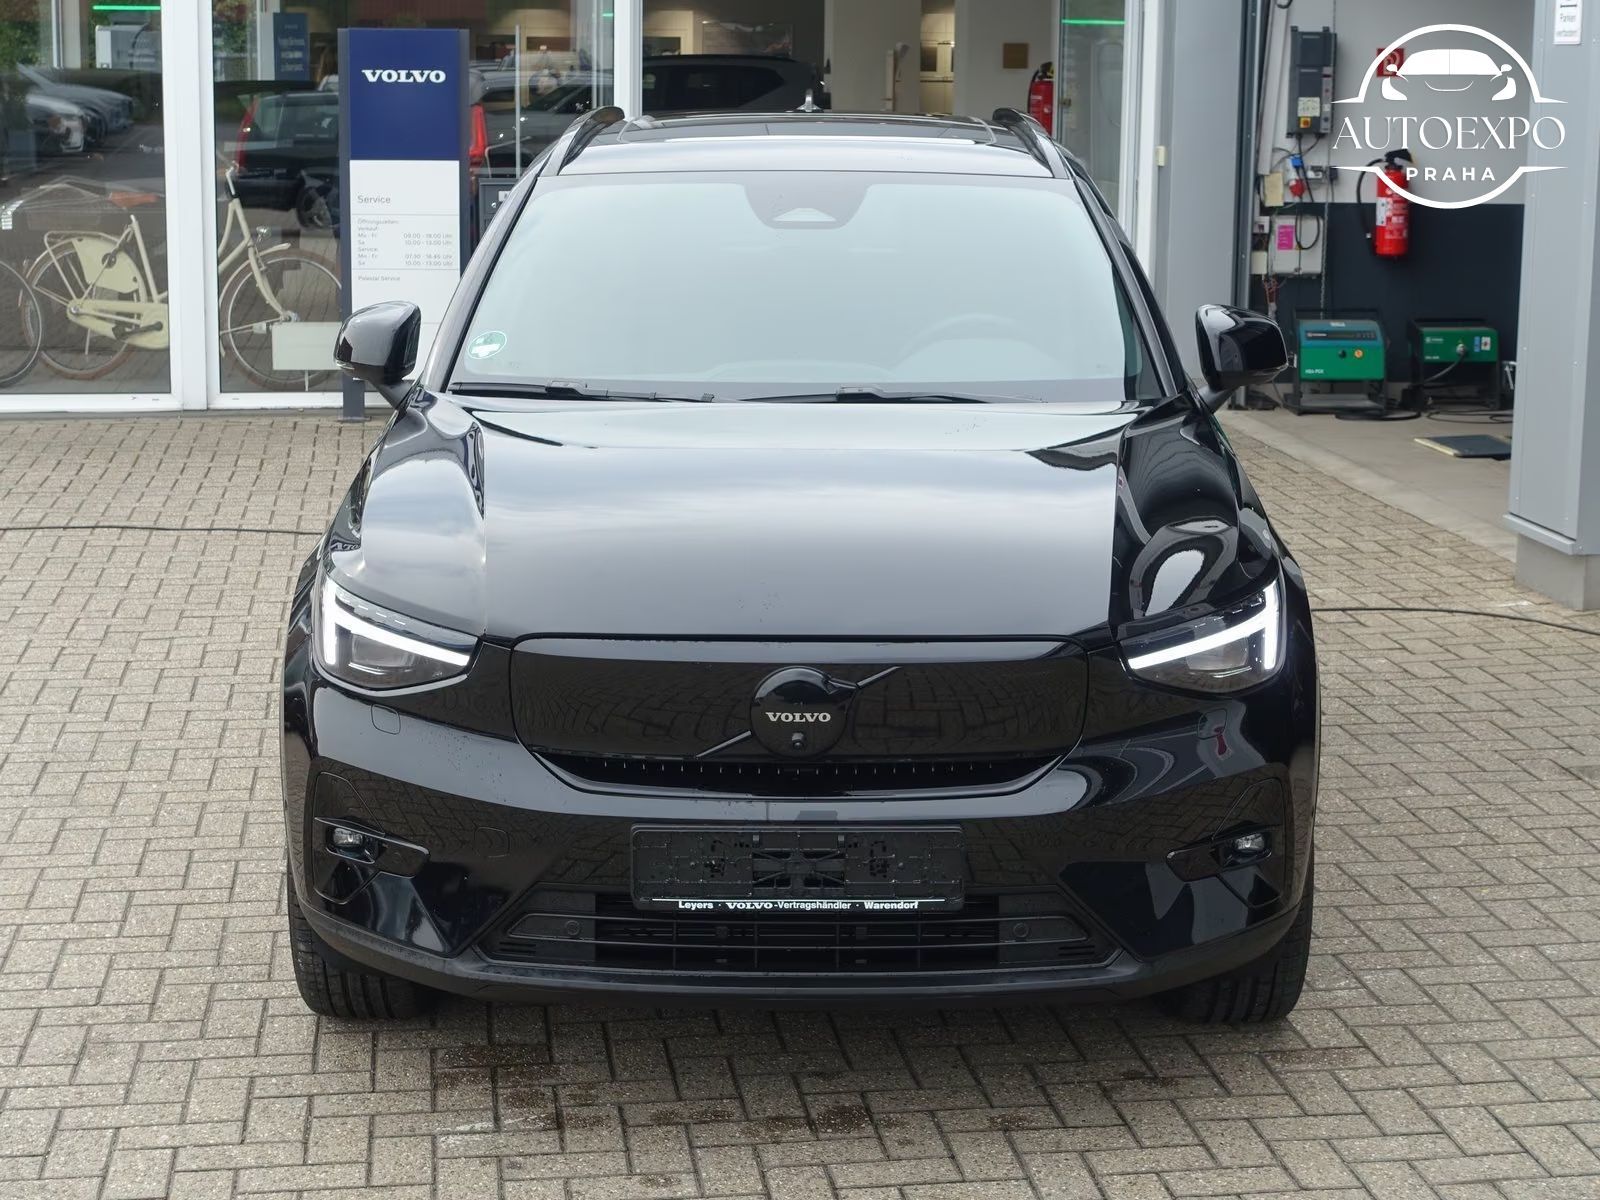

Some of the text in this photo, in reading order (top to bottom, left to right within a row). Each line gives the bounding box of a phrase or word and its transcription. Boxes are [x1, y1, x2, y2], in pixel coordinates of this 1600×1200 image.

[362, 70, 446, 83] VOLVO
[358, 195, 390, 204] Service
[766, 712, 831, 722] VOLVO
[678, 901, 714, 910] Leyers
[864, 901, 919, 910] Warendorf
